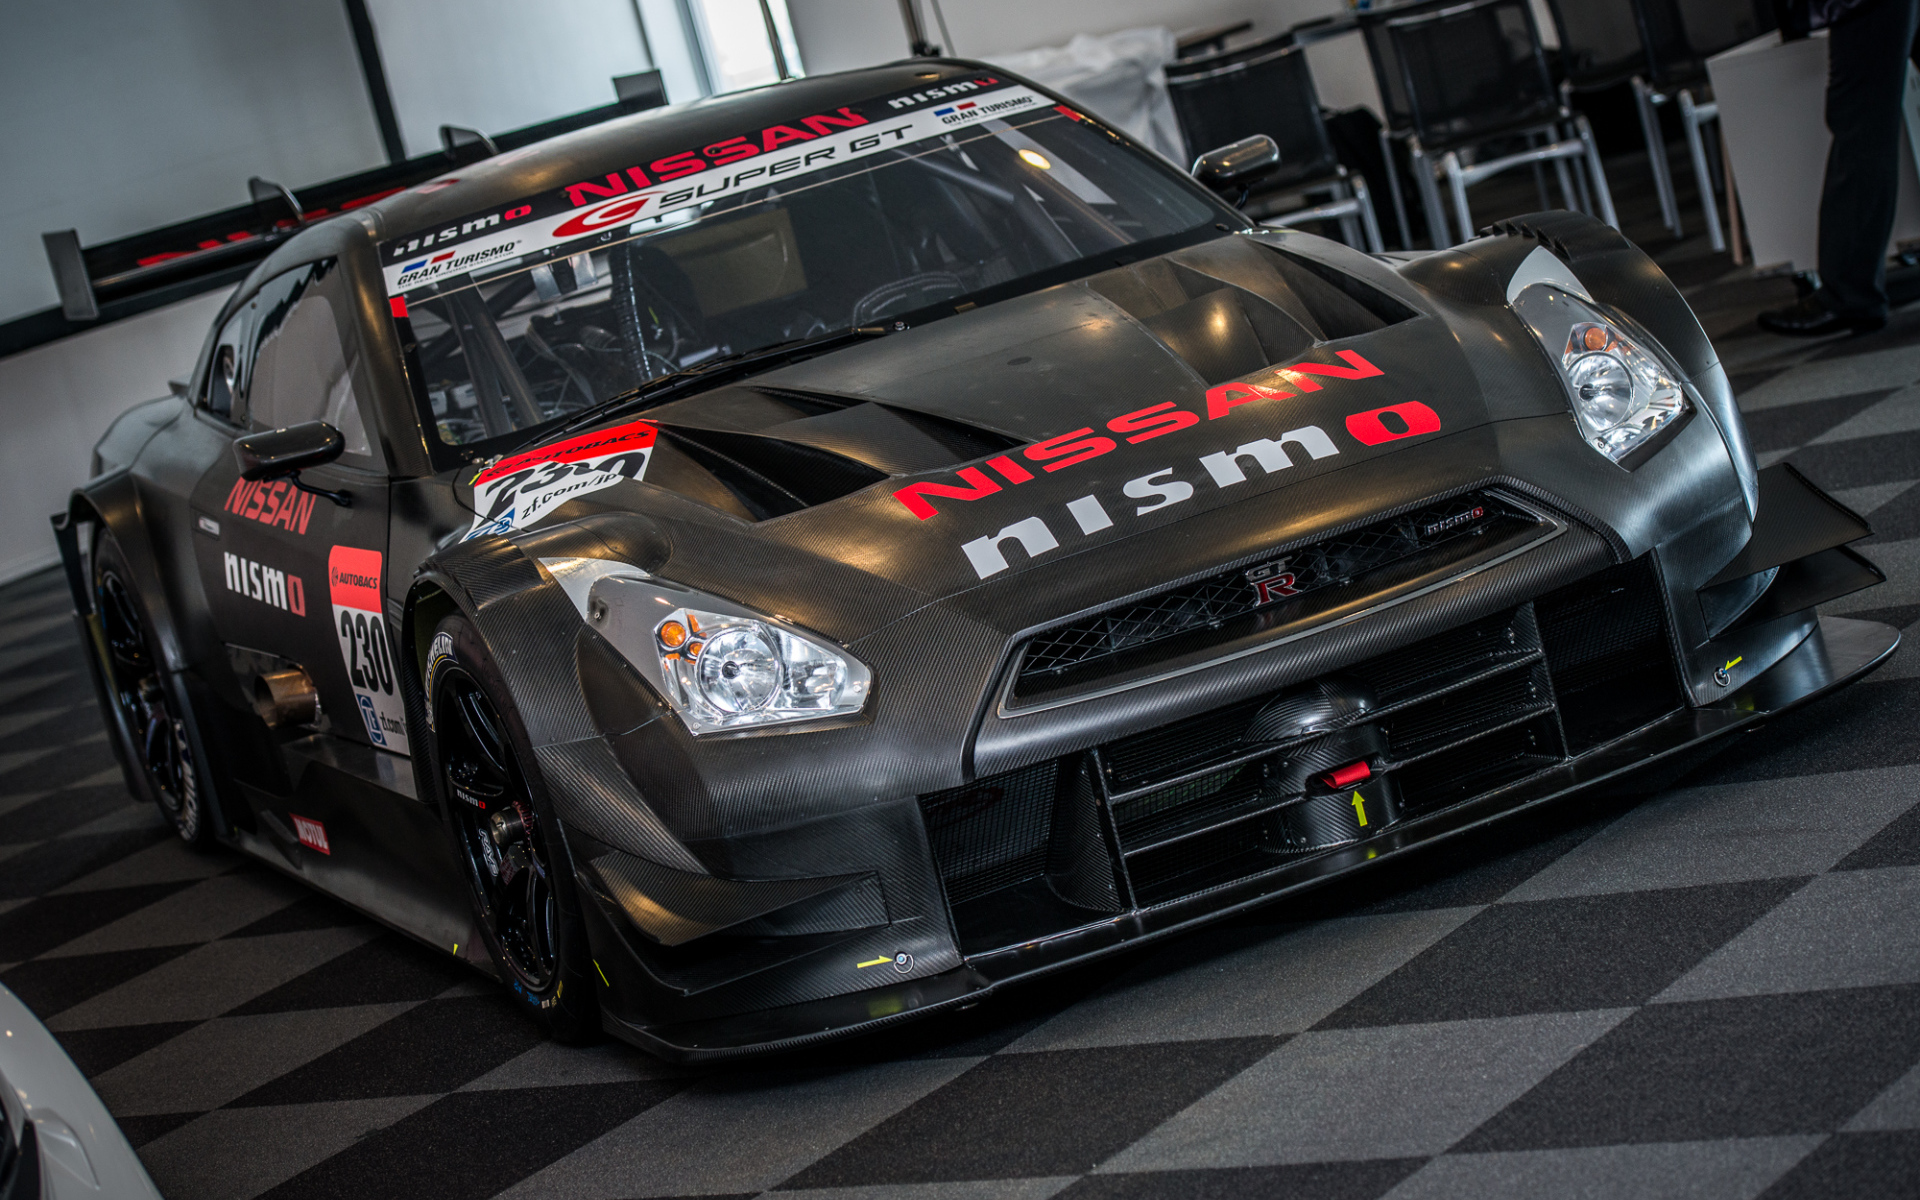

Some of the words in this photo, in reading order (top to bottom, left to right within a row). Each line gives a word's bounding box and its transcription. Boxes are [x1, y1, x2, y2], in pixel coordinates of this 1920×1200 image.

[888, 77, 998, 109] nismo
[942, 109, 979, 125] GRAN
[565, 107, 869, 207] NISSAN
[659, 146, 836, 209] SUPER
[850, 124, 913, 153] GT
[393, 204, 532, 257] nismo
[398, 263, 439, 286] GRAN
[446, 241, 515, 269] TURISMO
[514, 429, 652, 465] AUTOBACS
[892, 349, 1385, 521] NISSAN
[224, 476, 317, 535] NISSAN
[475, 452, 646, 528] 230
[521, 473, 617, 520] zf.com/jp
[960, 400, 1441, 579] nismo
[1424, 506, 1484, 536] nismo
[224, 551, 306, 618] nismo
[339, 572, 378, 590] AUTOBACS
[340, 610, 394, 696] 230
[456, 788, 486, 810] nismo
[294, 817, 328, 850] MOTUL
